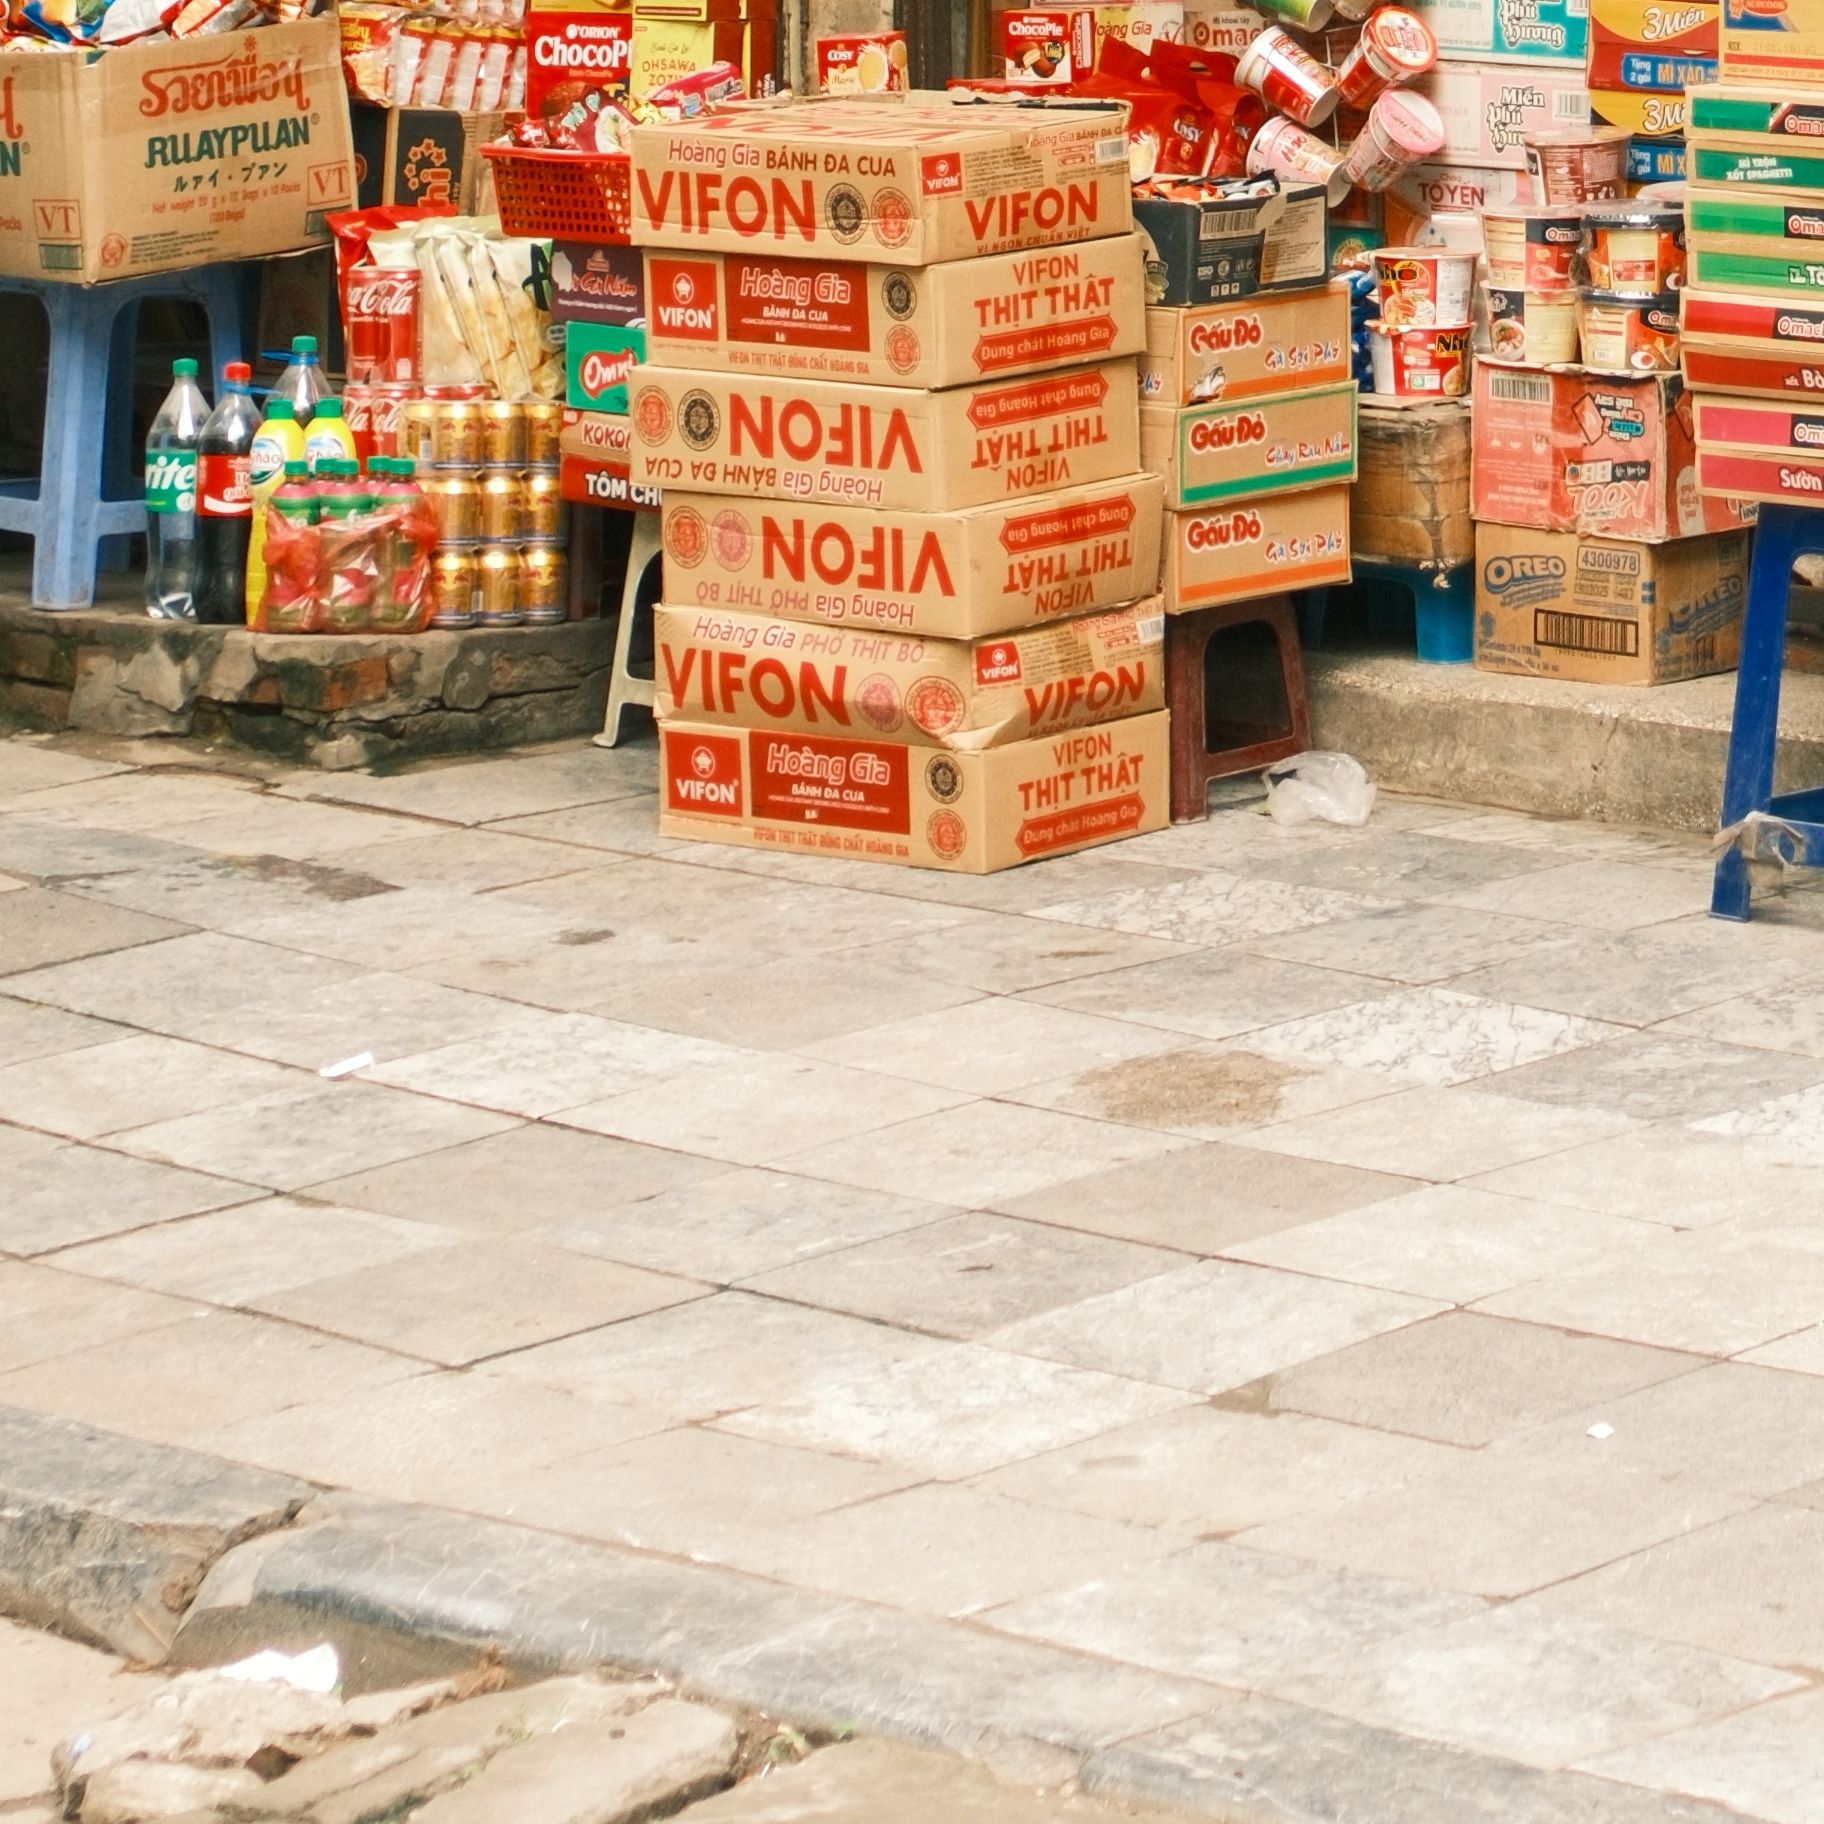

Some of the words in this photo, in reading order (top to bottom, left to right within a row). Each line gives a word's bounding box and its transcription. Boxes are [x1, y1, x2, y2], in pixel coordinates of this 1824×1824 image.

[145, 115, 310, 169] RUAYPUAN
[669, 139, 728, 168] Hoàng
[732, 143, 761, 167] Gia
[766, 145, 819, 173] BÁNH
[824, 154, 851, 174] ĐA
[857, 156, 895, 177] CUA
[313, 167, 348, 196] VT
[37, 206, 75, 233] VT
[637, 167, 816, 242] VIFON
[965, 181, 1099, 242] VIFON
[740, 268, 812, 306] Hoàng
[815, 274, 851, 305] Gia
[1013, 254, 1079, 286] VIFON
[975, 293, 1038, 332] THỊT
[1044, 274, 1114, 315] THẬT
[730, 393, 923, 473] VIFON
[585, 471, 626, 500] TÔM
[1486, 556, 1566, 592] OREO
[1581, 554, 1637, 572] 4300978
[662, 643, 851, 727] VIFON
